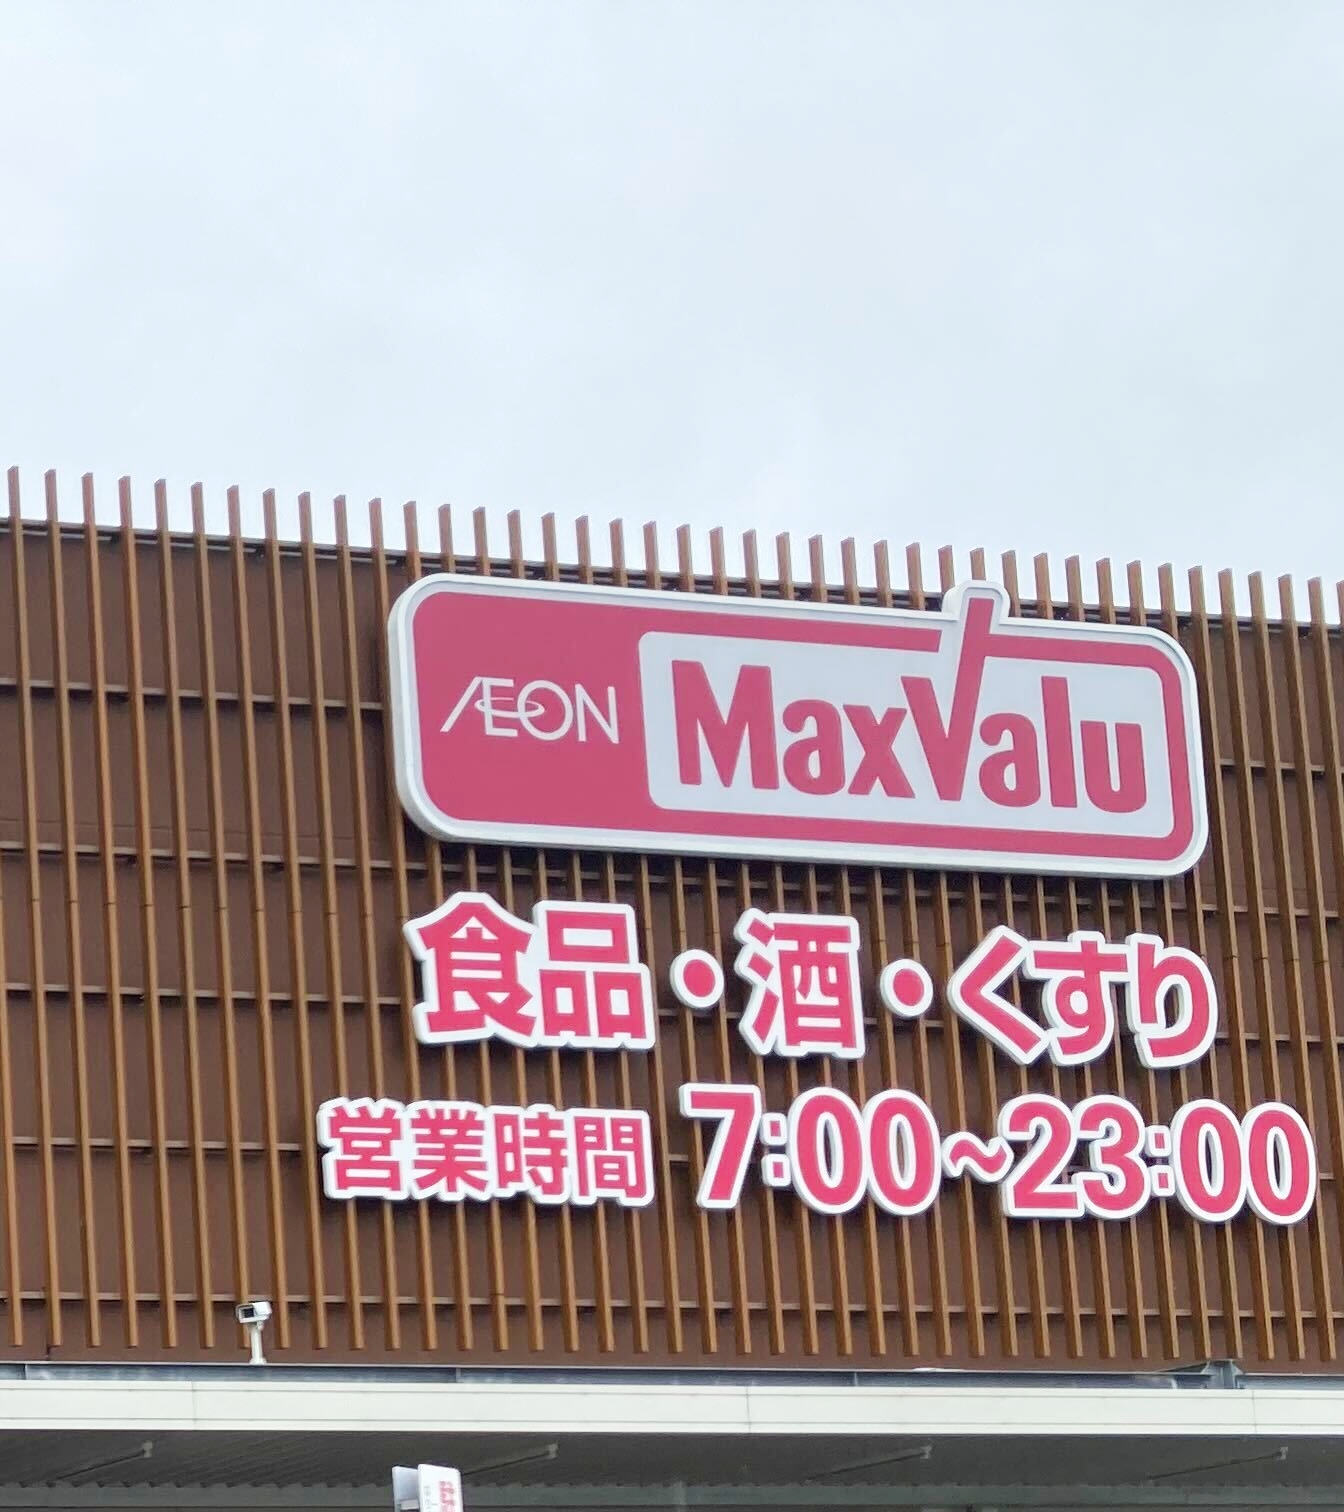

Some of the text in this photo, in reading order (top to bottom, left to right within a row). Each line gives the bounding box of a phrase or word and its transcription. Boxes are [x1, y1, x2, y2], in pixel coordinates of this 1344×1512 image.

[670, 597, 1147, 813] MaxValu
[318, 1096, 655, 1205] 営業時間
